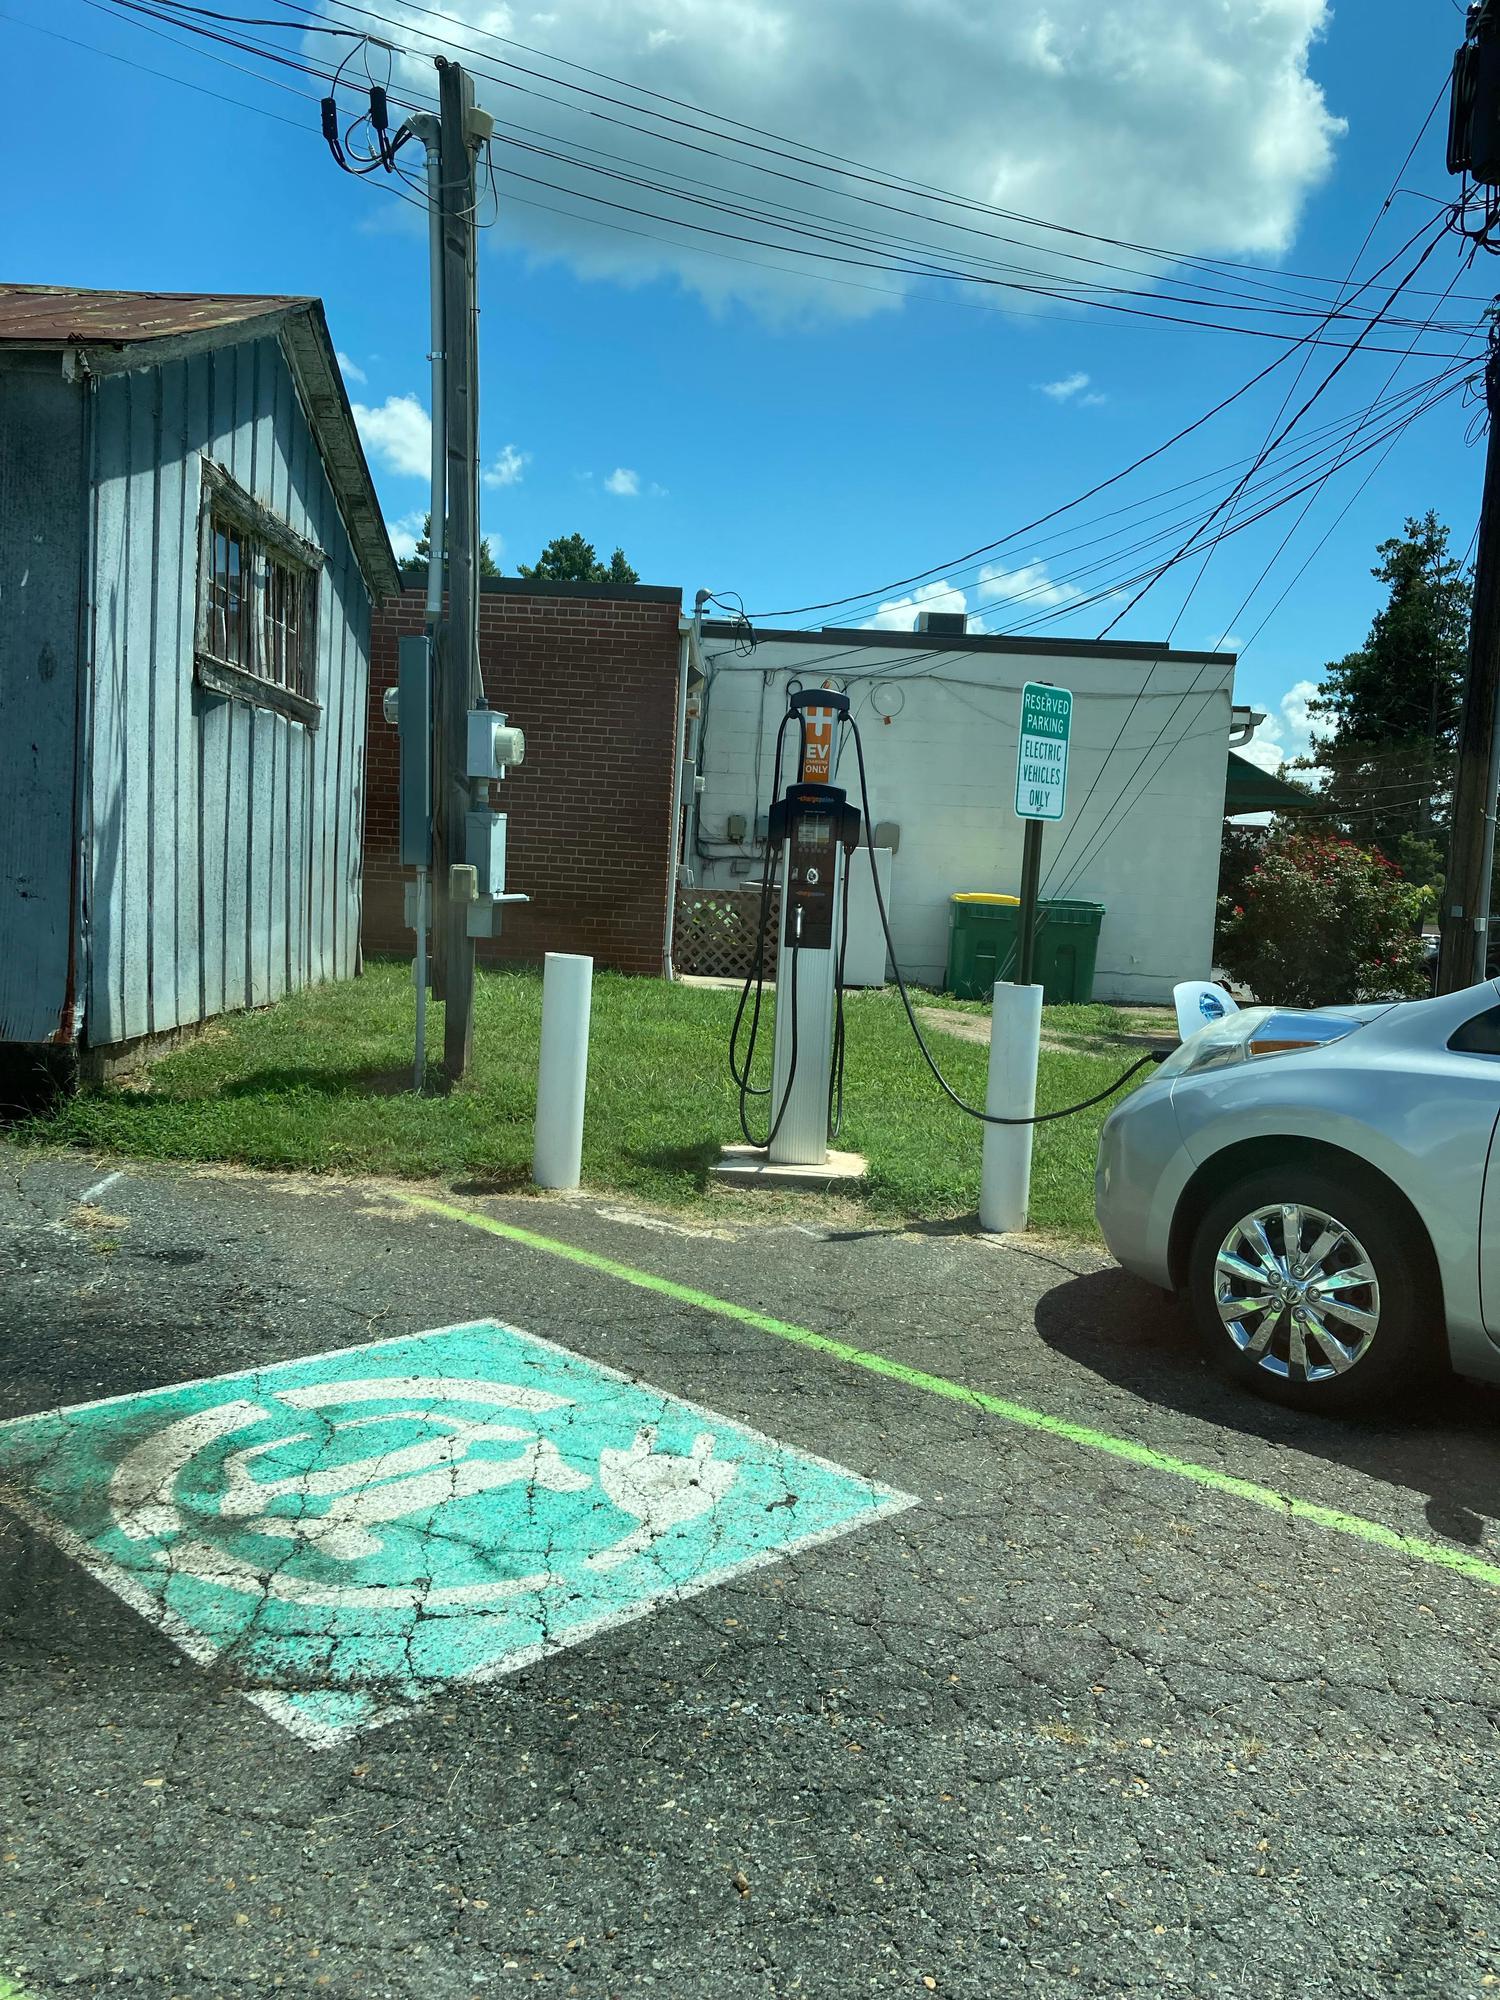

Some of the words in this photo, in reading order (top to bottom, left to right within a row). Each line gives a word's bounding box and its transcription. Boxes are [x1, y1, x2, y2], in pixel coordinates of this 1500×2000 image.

[1025, 693, 1069, 715] RESERVED
[1027, 714, 1064, 734] PARKING
[806, 743, 829, 759] EV
[1025, 740, 1062, 762] ELECTRIC
[805, 765, 829, 774] ONLY
[1023, 764, 1060, 785] VEHICLES
[1029, 789, 1050, 808] ONLY
